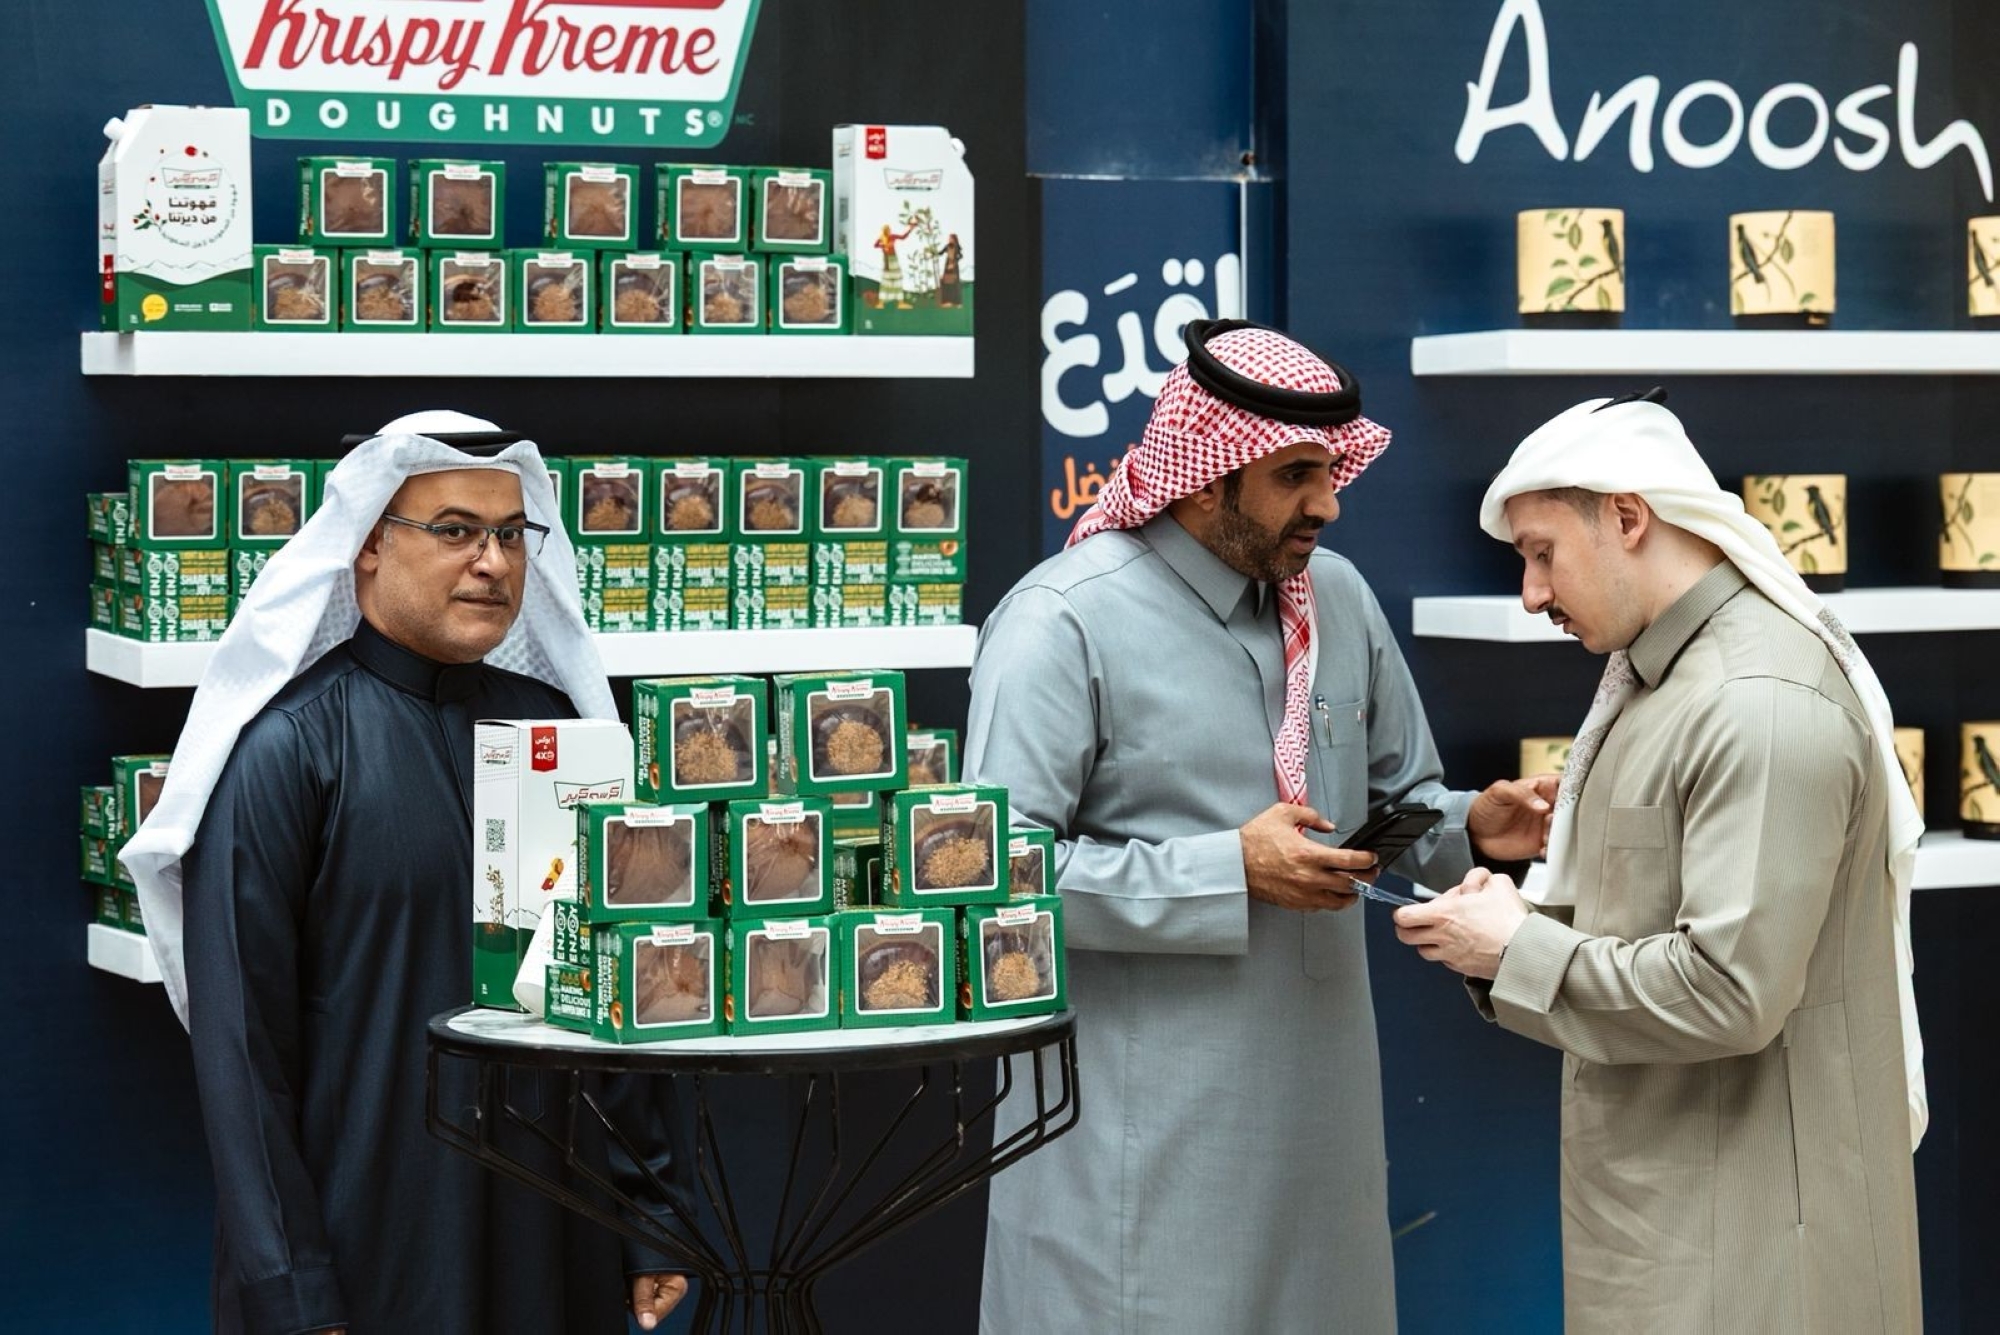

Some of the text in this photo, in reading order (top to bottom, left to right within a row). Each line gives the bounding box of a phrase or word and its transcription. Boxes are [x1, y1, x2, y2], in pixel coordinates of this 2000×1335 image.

[244, 0, 720, 90] Krispy Kreme
[1455, 0, 1994, 203] Anoosh
[147, 552, 163, 596] ENJOY
[163, 552, 179, 596] ENJOY
[147, 598, 163, 642] ENJOY
[163, 598, 179, 642] ENJOY
[555, 903, 566, 960] ENJOY
[567, 904, 580, 963] ENJOY
